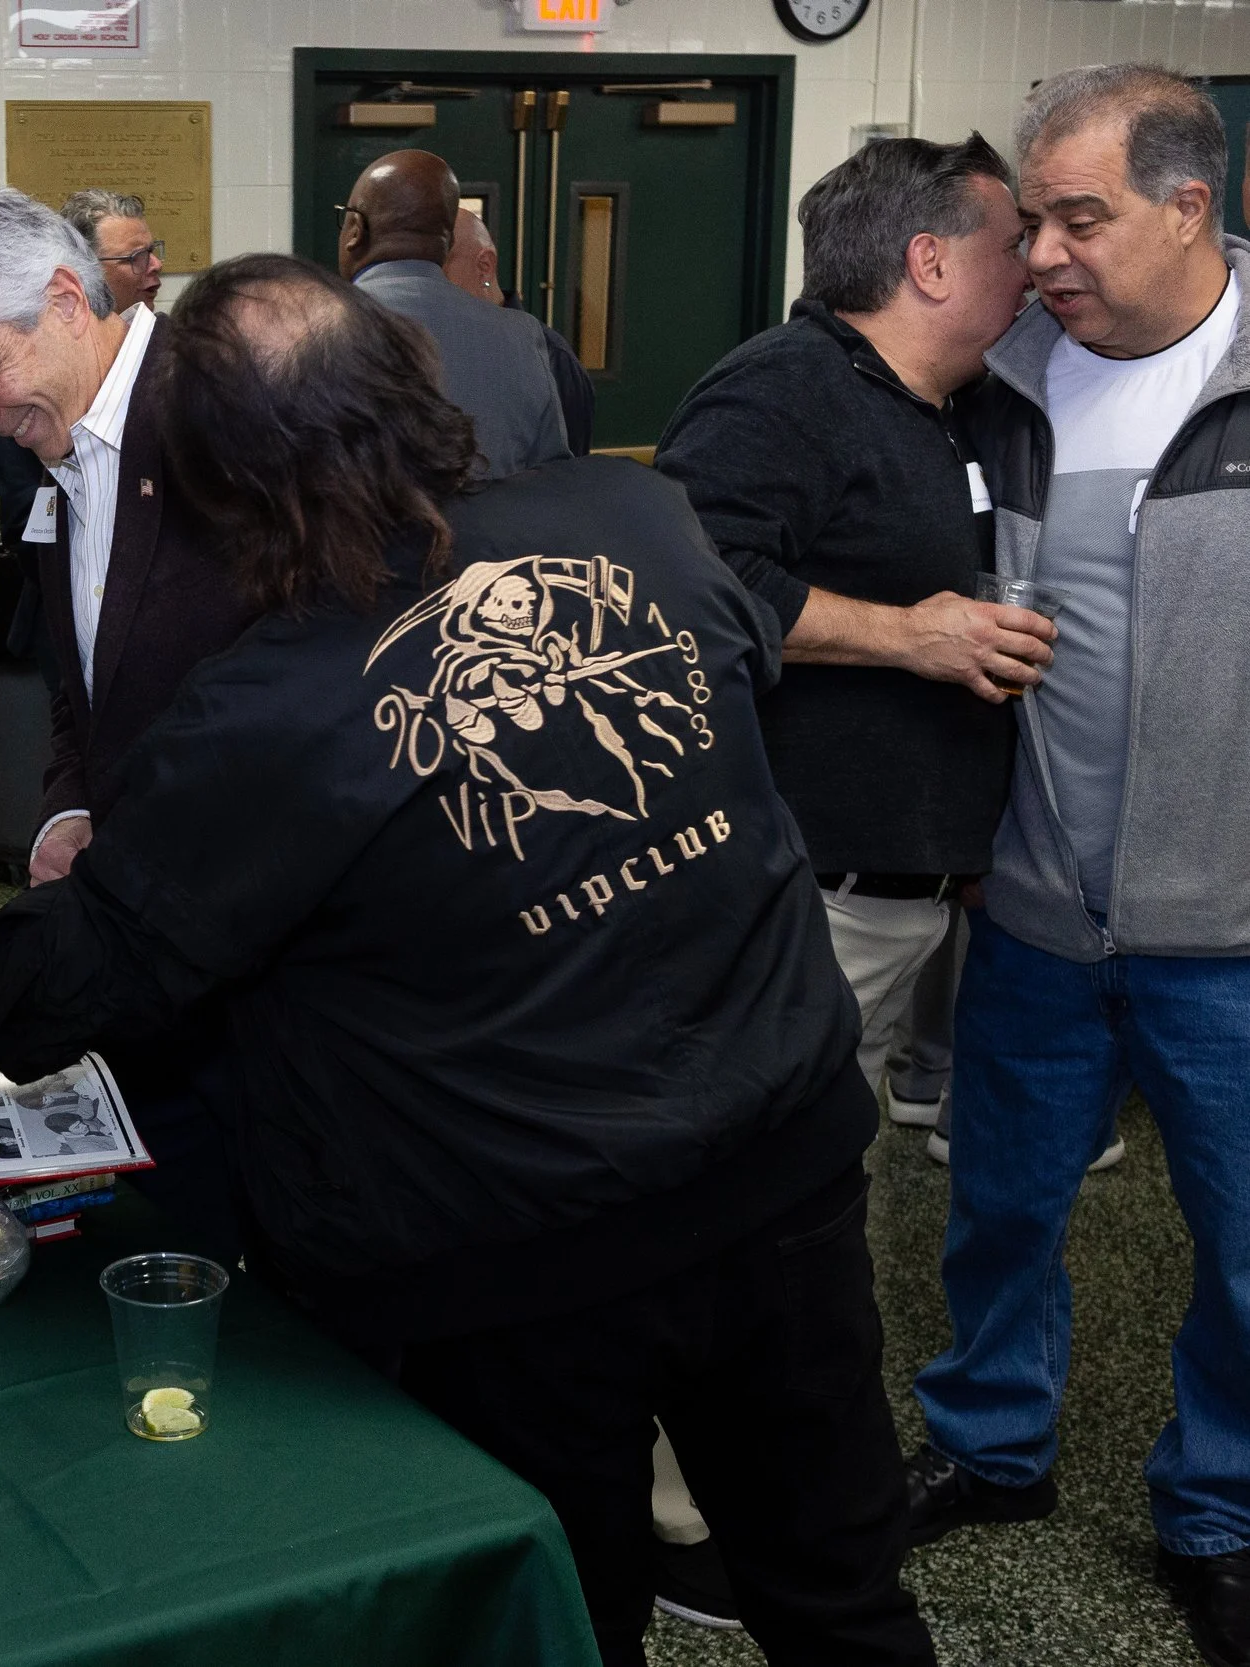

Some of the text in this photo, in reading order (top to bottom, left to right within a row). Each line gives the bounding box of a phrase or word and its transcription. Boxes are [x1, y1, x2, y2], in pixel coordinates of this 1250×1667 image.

[816, 10, 827, 25] 6
[831, 5, 841, 20] 5
[35, 1189, 60, 1201] VOL.
[63, 1183, 79, 1196] XX
